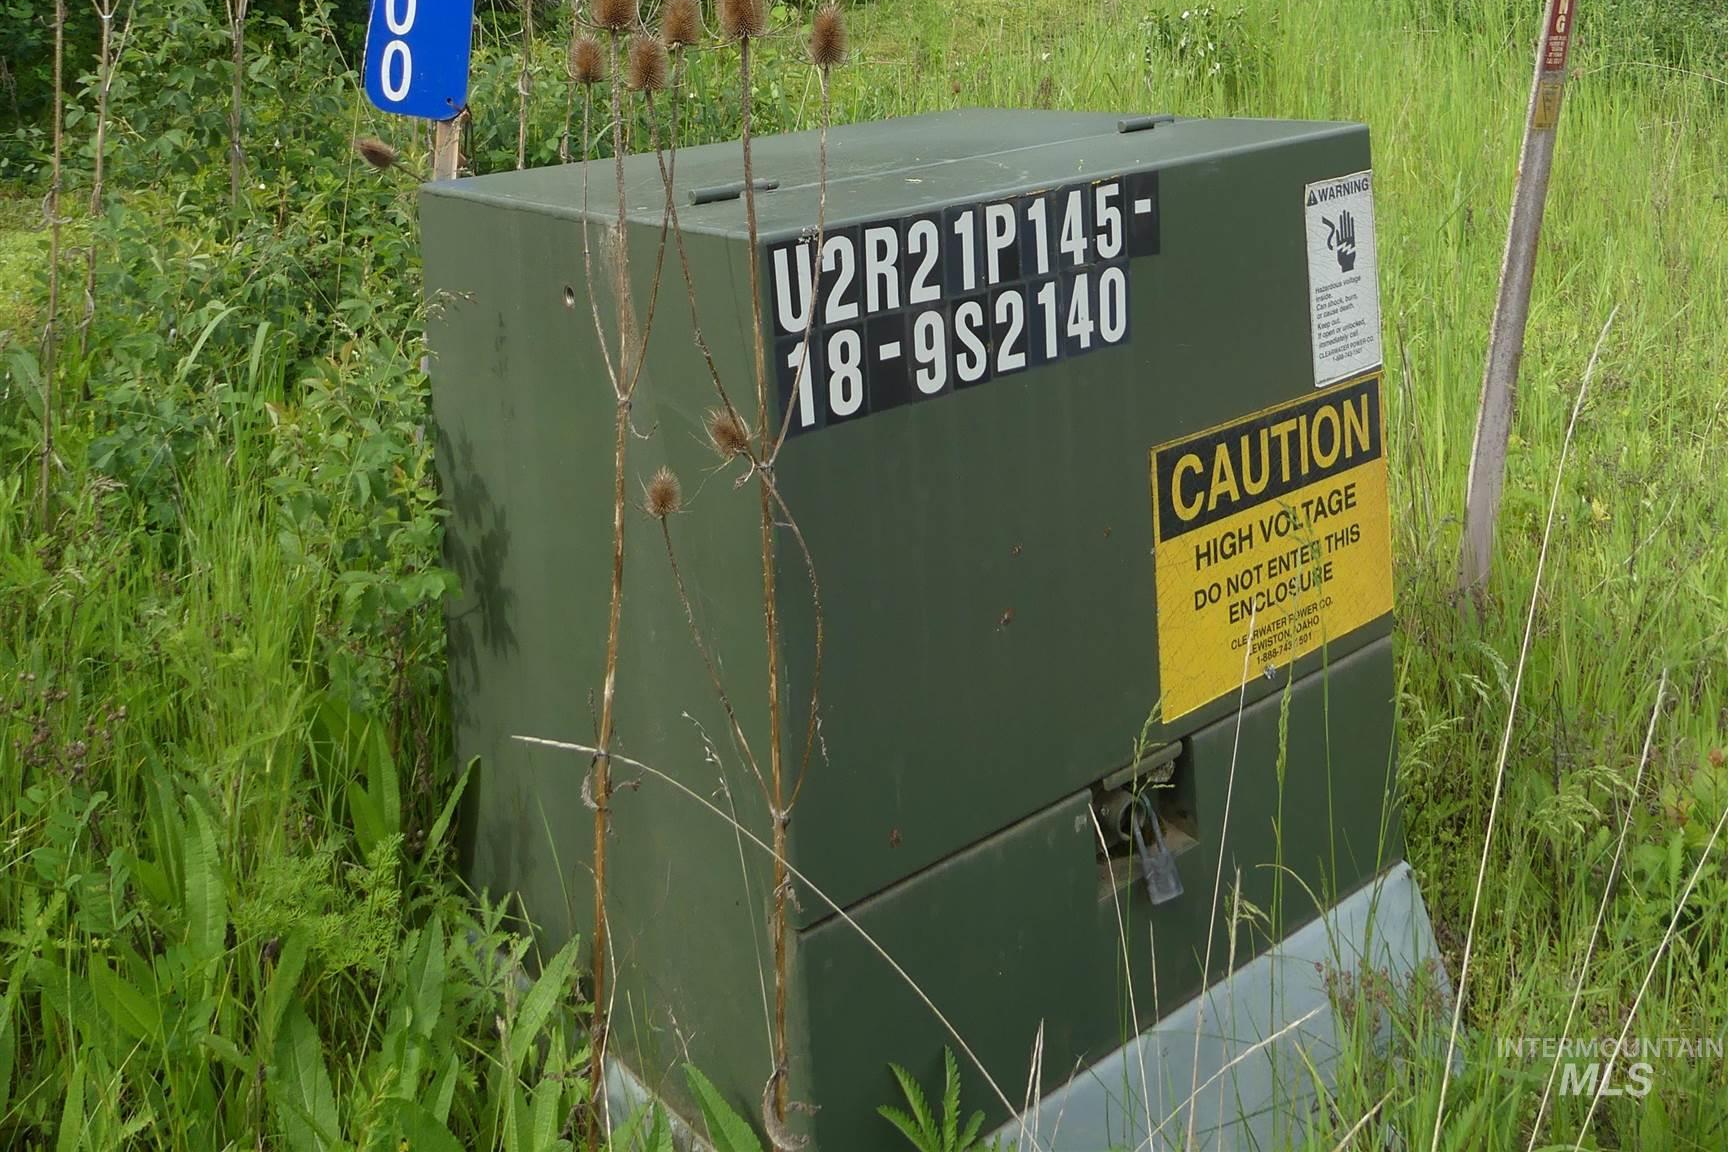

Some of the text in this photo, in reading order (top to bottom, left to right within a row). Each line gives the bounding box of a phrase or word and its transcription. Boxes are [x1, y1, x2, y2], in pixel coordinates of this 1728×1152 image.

[1317, 177, 1369, 202] WARNING
[1171, 392, 1371, 522] CAUTION
[1195, 483, 1357, 571] HIGH VOLTAGE
[1194, 582, 1222, 611] DO
[1226, 564, 1263, 597] NOT
[1325, 523, 1360, 553] THIS
[1231, 616, 1287, 650] CLERWATER
[1294, 615, 1320, 634] DAHO
[1257, 632, 1312, 665] 1-888-7431501
